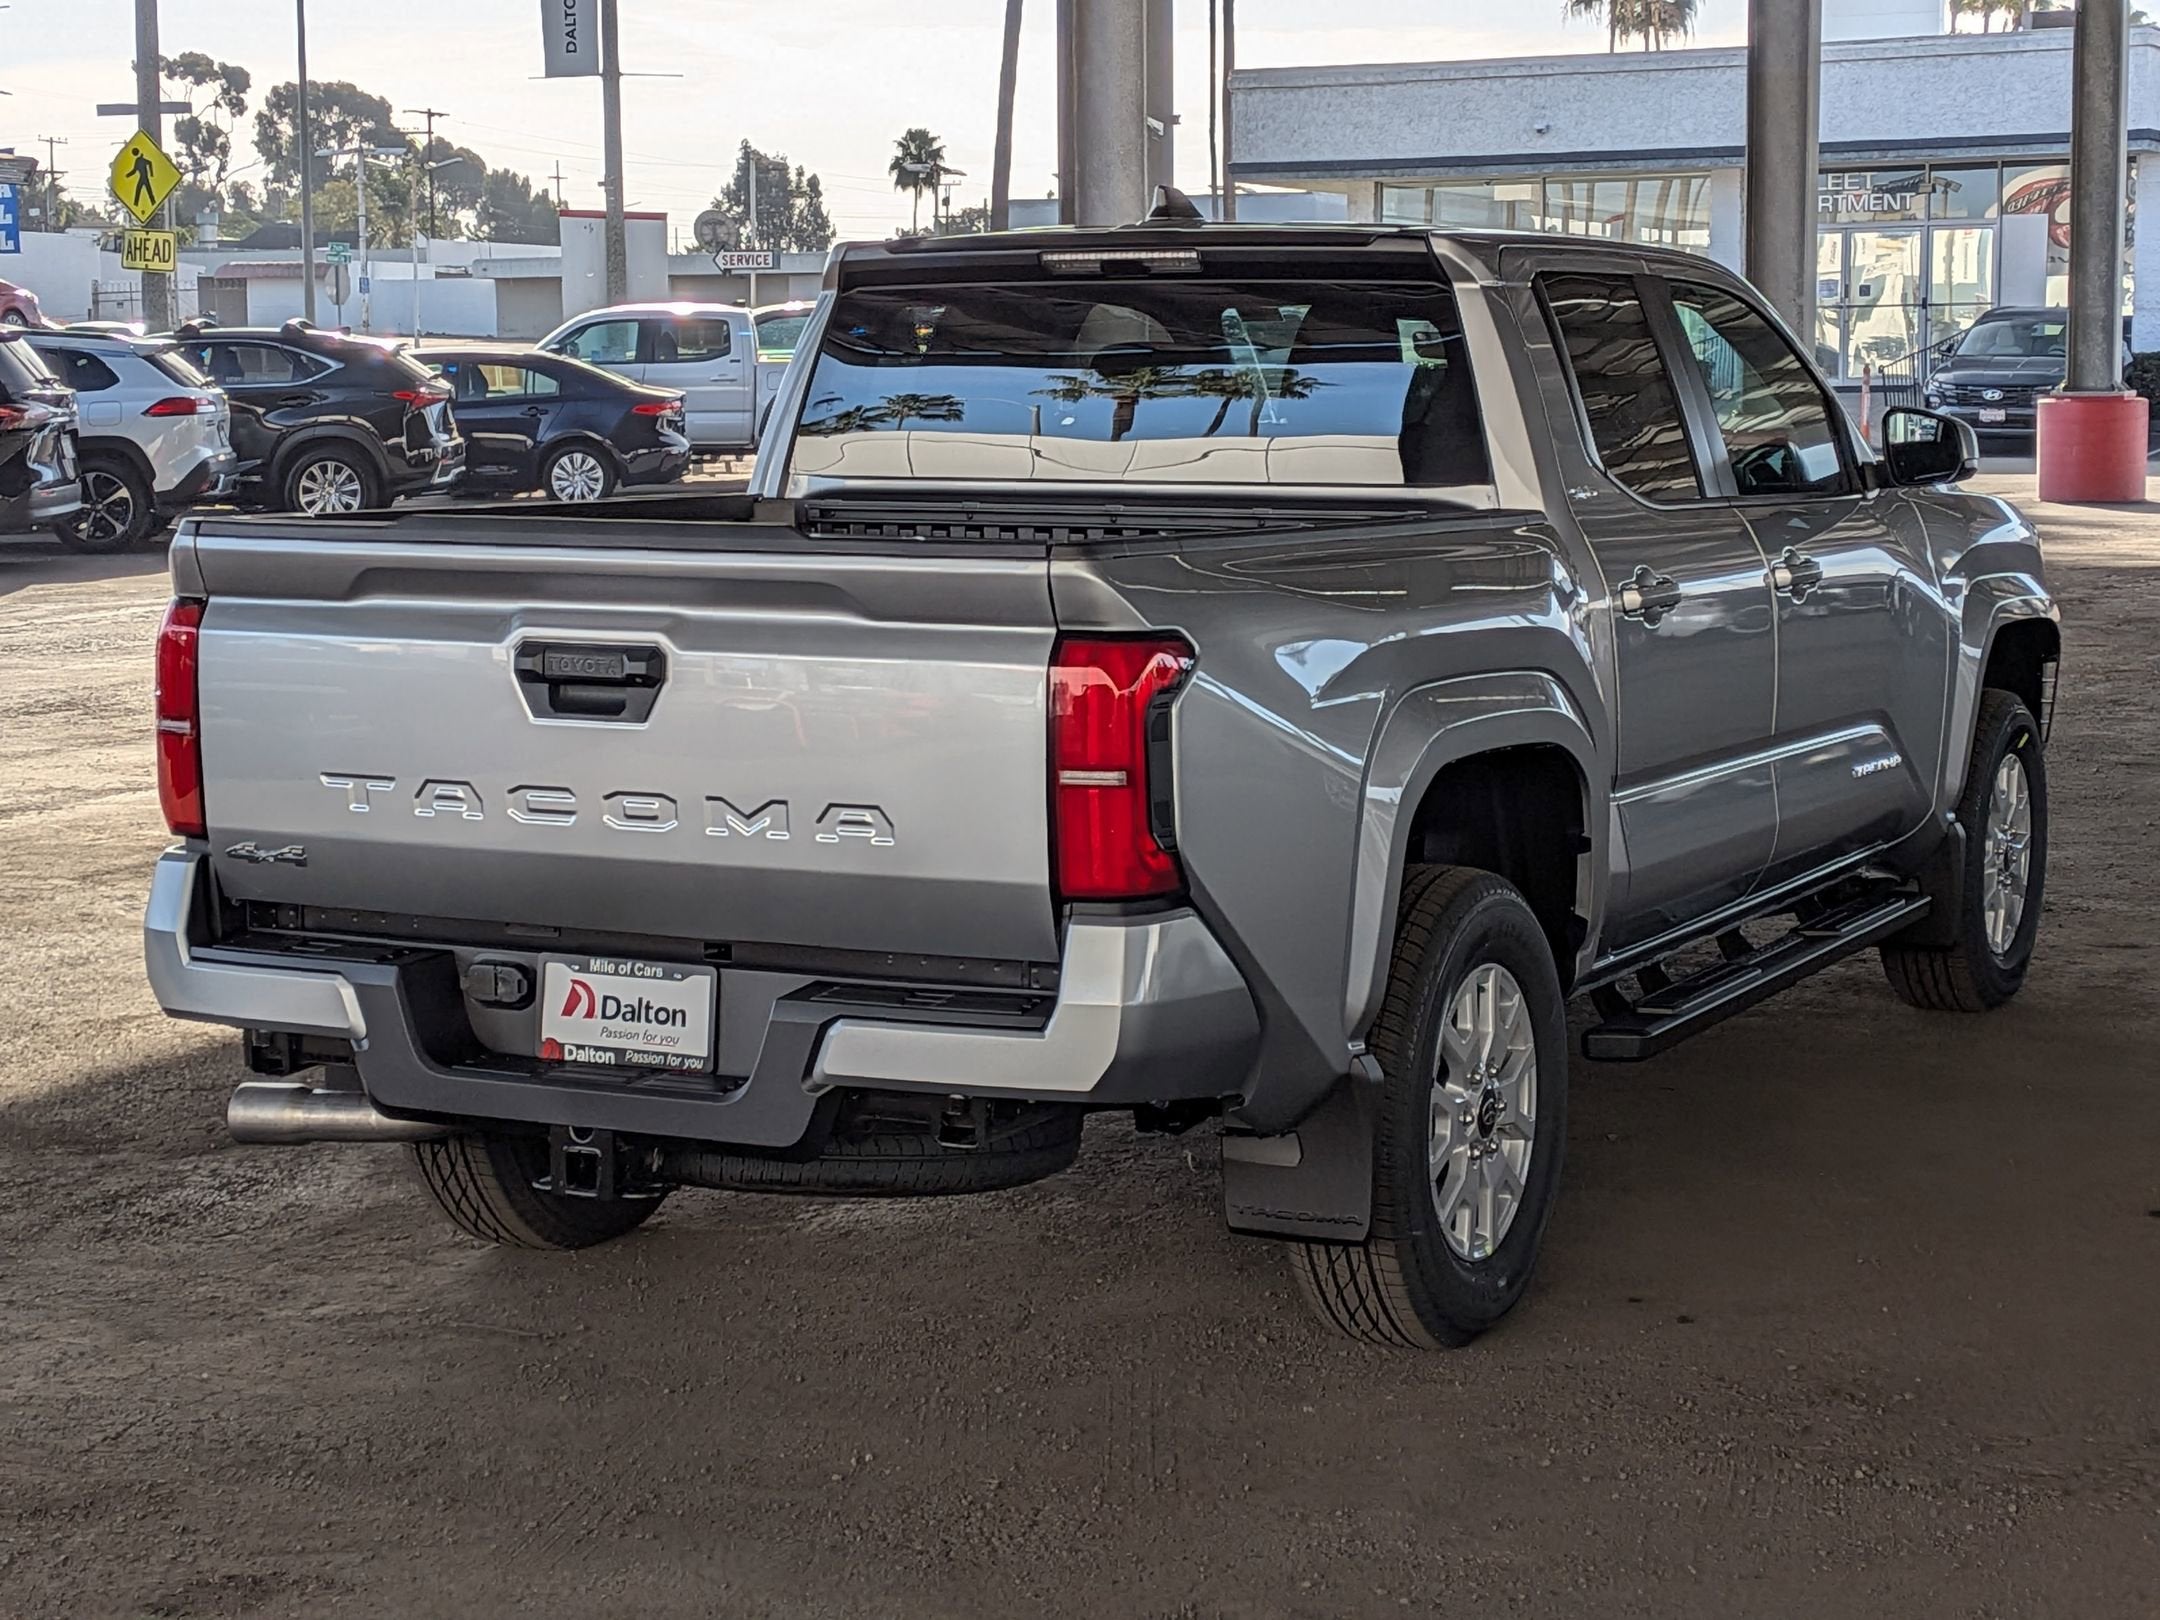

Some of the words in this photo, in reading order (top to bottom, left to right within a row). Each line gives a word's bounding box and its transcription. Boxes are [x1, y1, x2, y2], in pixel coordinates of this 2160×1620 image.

[125, 236, 172, 263] AHEAD
[721, 254, 770, 267] SERVICE
[549, 655, 618, 677] TOYOTA
[318, 770, 896, 846] TACOMA
[589, 958, 615, 974] Mile
[618, 961, 632, 976] of
[634, 962, 663, 978] Cars
[600, 994, 687, 1028] Dalton
[599, 1026, 640, 1041] Passion
[642, 1028, 658, 1042] for
[659, 1034, 681, 1046] you
[563, 1044, 616, 1065] Dalton
[624, 1049, 665, 1066] Passion
[666, 1053, 681, 1067] for
[682, 1057, 704, 1070] you
